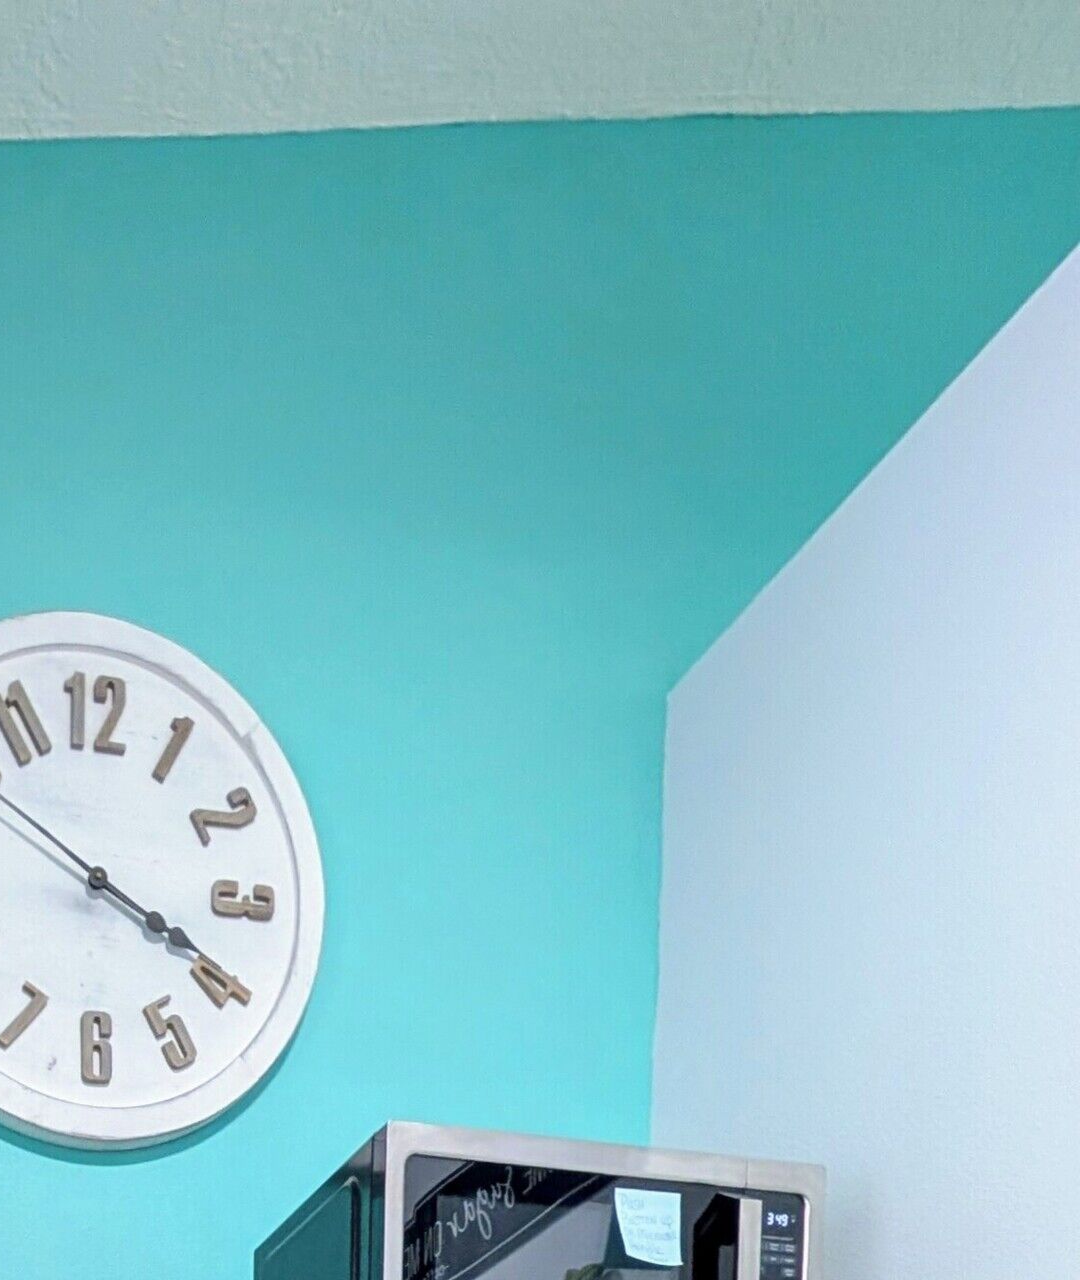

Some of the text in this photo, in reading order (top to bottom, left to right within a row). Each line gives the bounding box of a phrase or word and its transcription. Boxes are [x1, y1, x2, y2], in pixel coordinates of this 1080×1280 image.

[63, 671, 127, 756] 12
[152, 715, 195, 784] 1
[190, 786, 257, 847] 2
[211, 879, 276, 922] 3
[190, 954, 254, 1010] 4
[80, 1010, 113, 1086] 6
[143, 995, 198, 1071] 5
